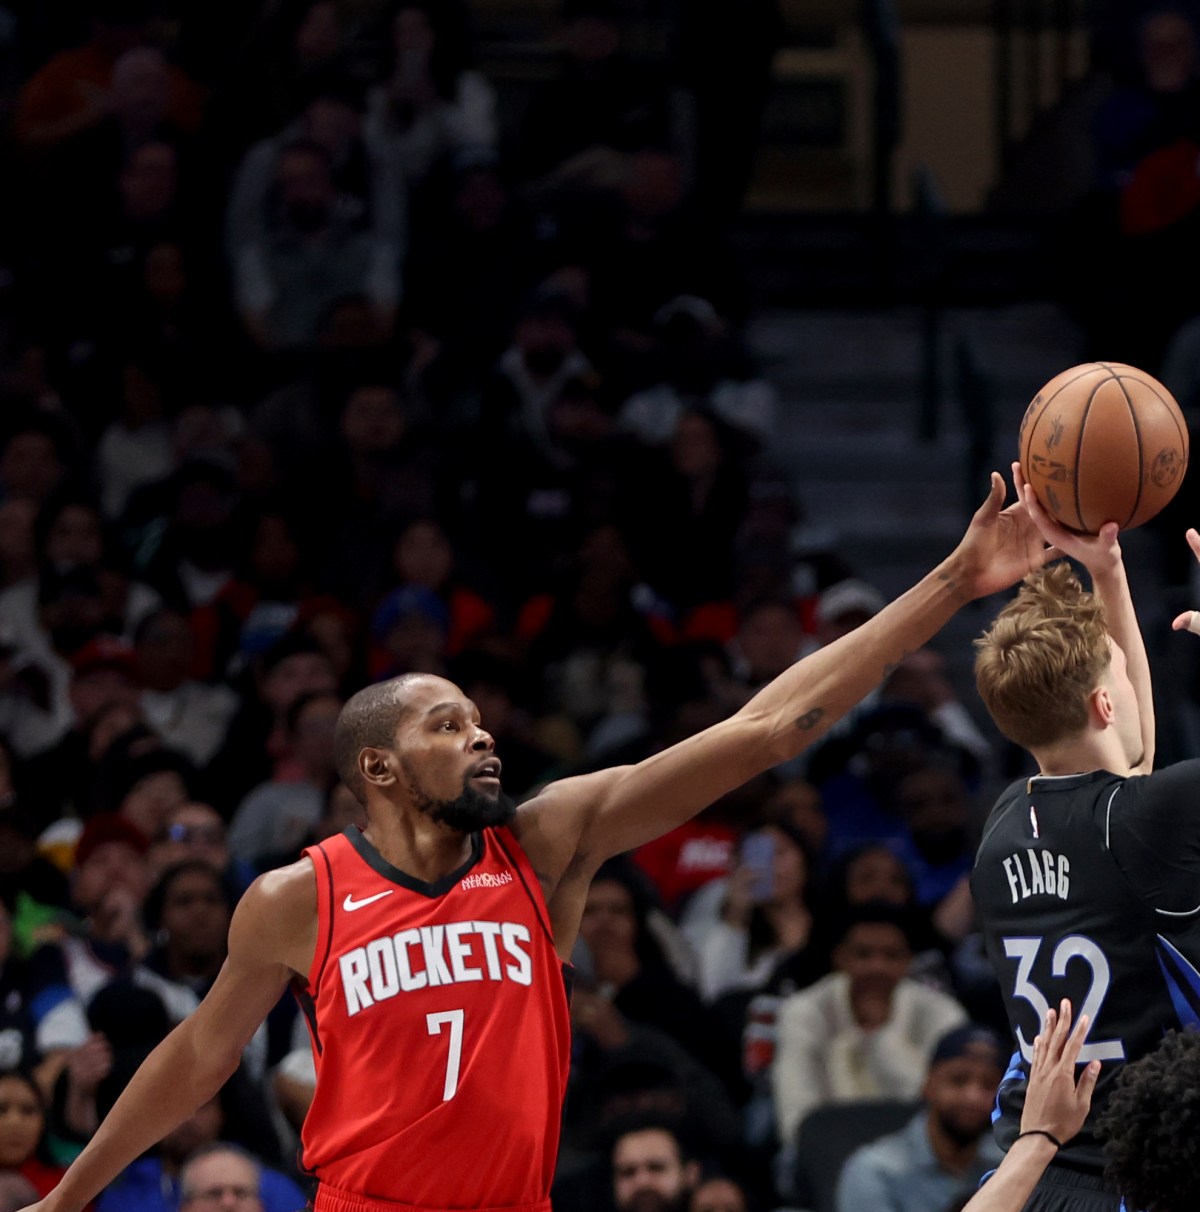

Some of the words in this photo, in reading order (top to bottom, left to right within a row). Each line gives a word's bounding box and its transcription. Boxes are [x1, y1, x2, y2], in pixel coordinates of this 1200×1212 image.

[1003, 849, 1070, 904] FLAGG
[339, 920, 532, 1017] ROCKETS
[1002, 934, 1126, 1065] 32
[426, 1009, 464, 1102] 7
